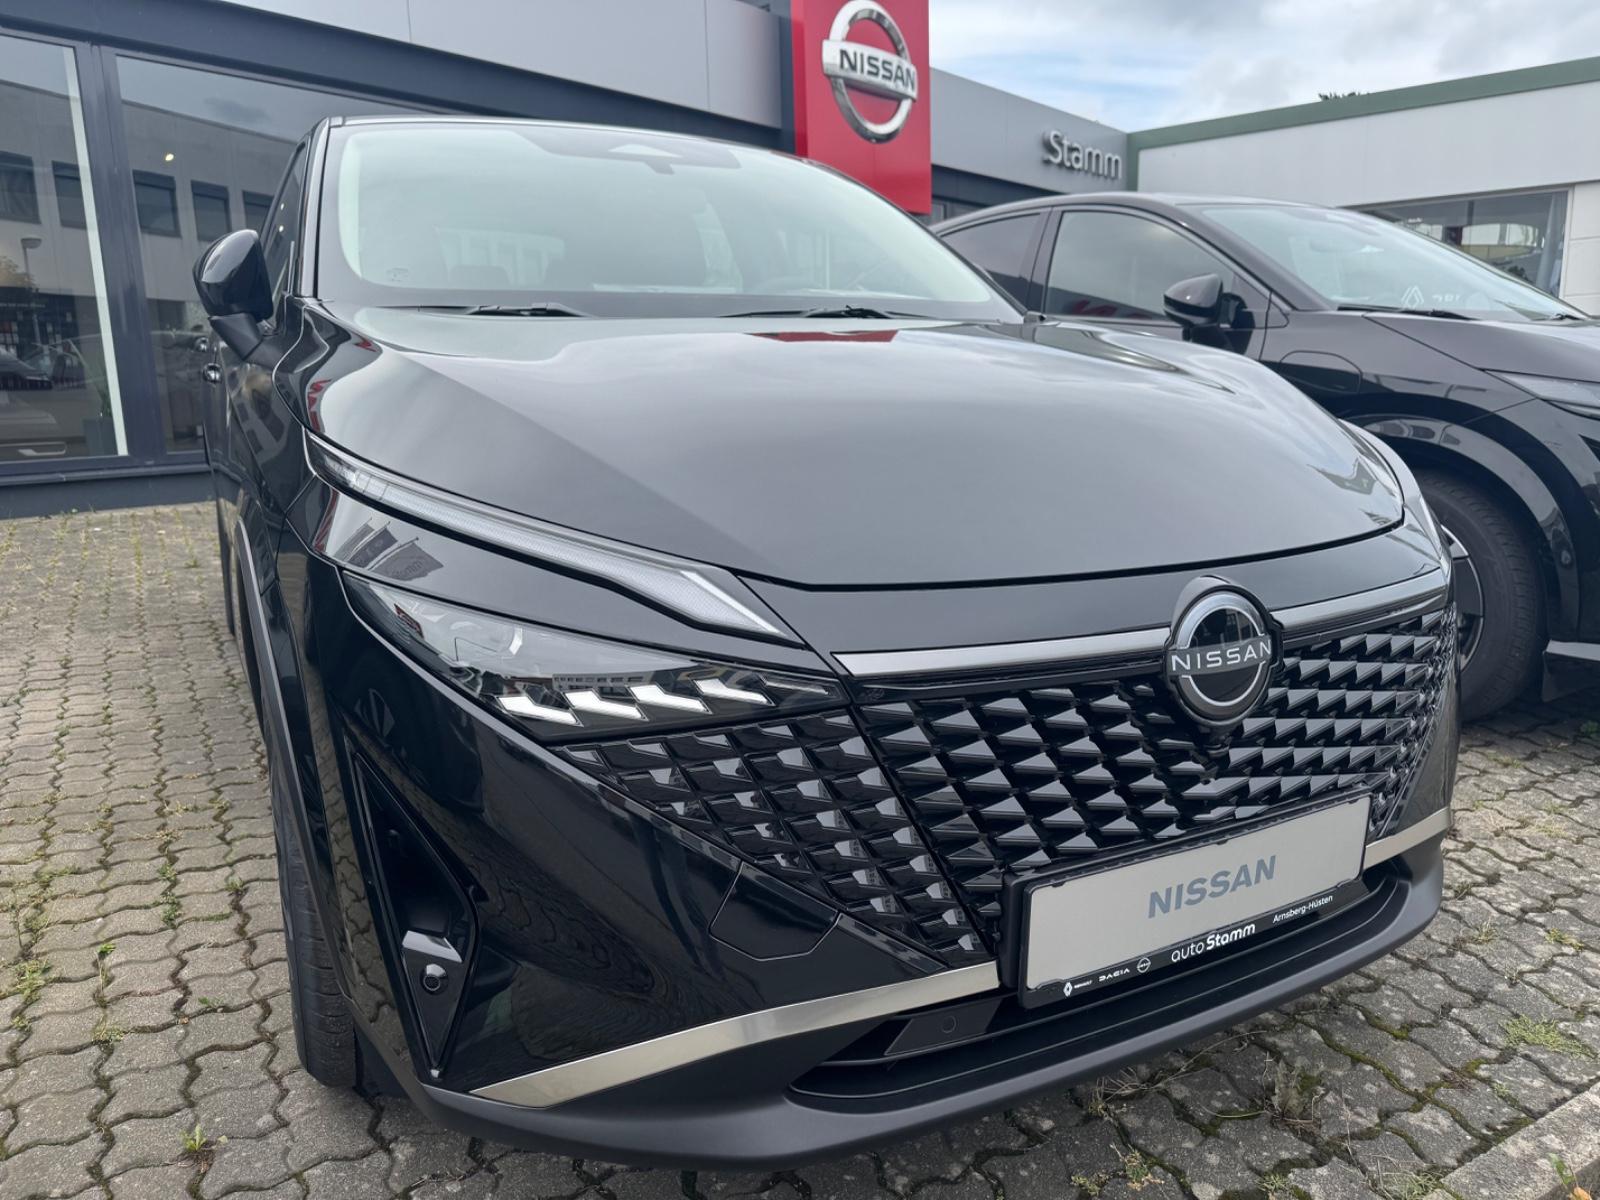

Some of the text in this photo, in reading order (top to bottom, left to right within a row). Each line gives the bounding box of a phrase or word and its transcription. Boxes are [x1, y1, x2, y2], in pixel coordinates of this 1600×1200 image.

[839, 49, 916, 92] NISSAN
[1047, 130, 1122, 180] Stamm
[1171, 639, 1272, 671] NISSAN
[1148, 855, 1276, 919] NISSAN
[1272, 894, 1334, 924] Arnsberg-Hüsten
